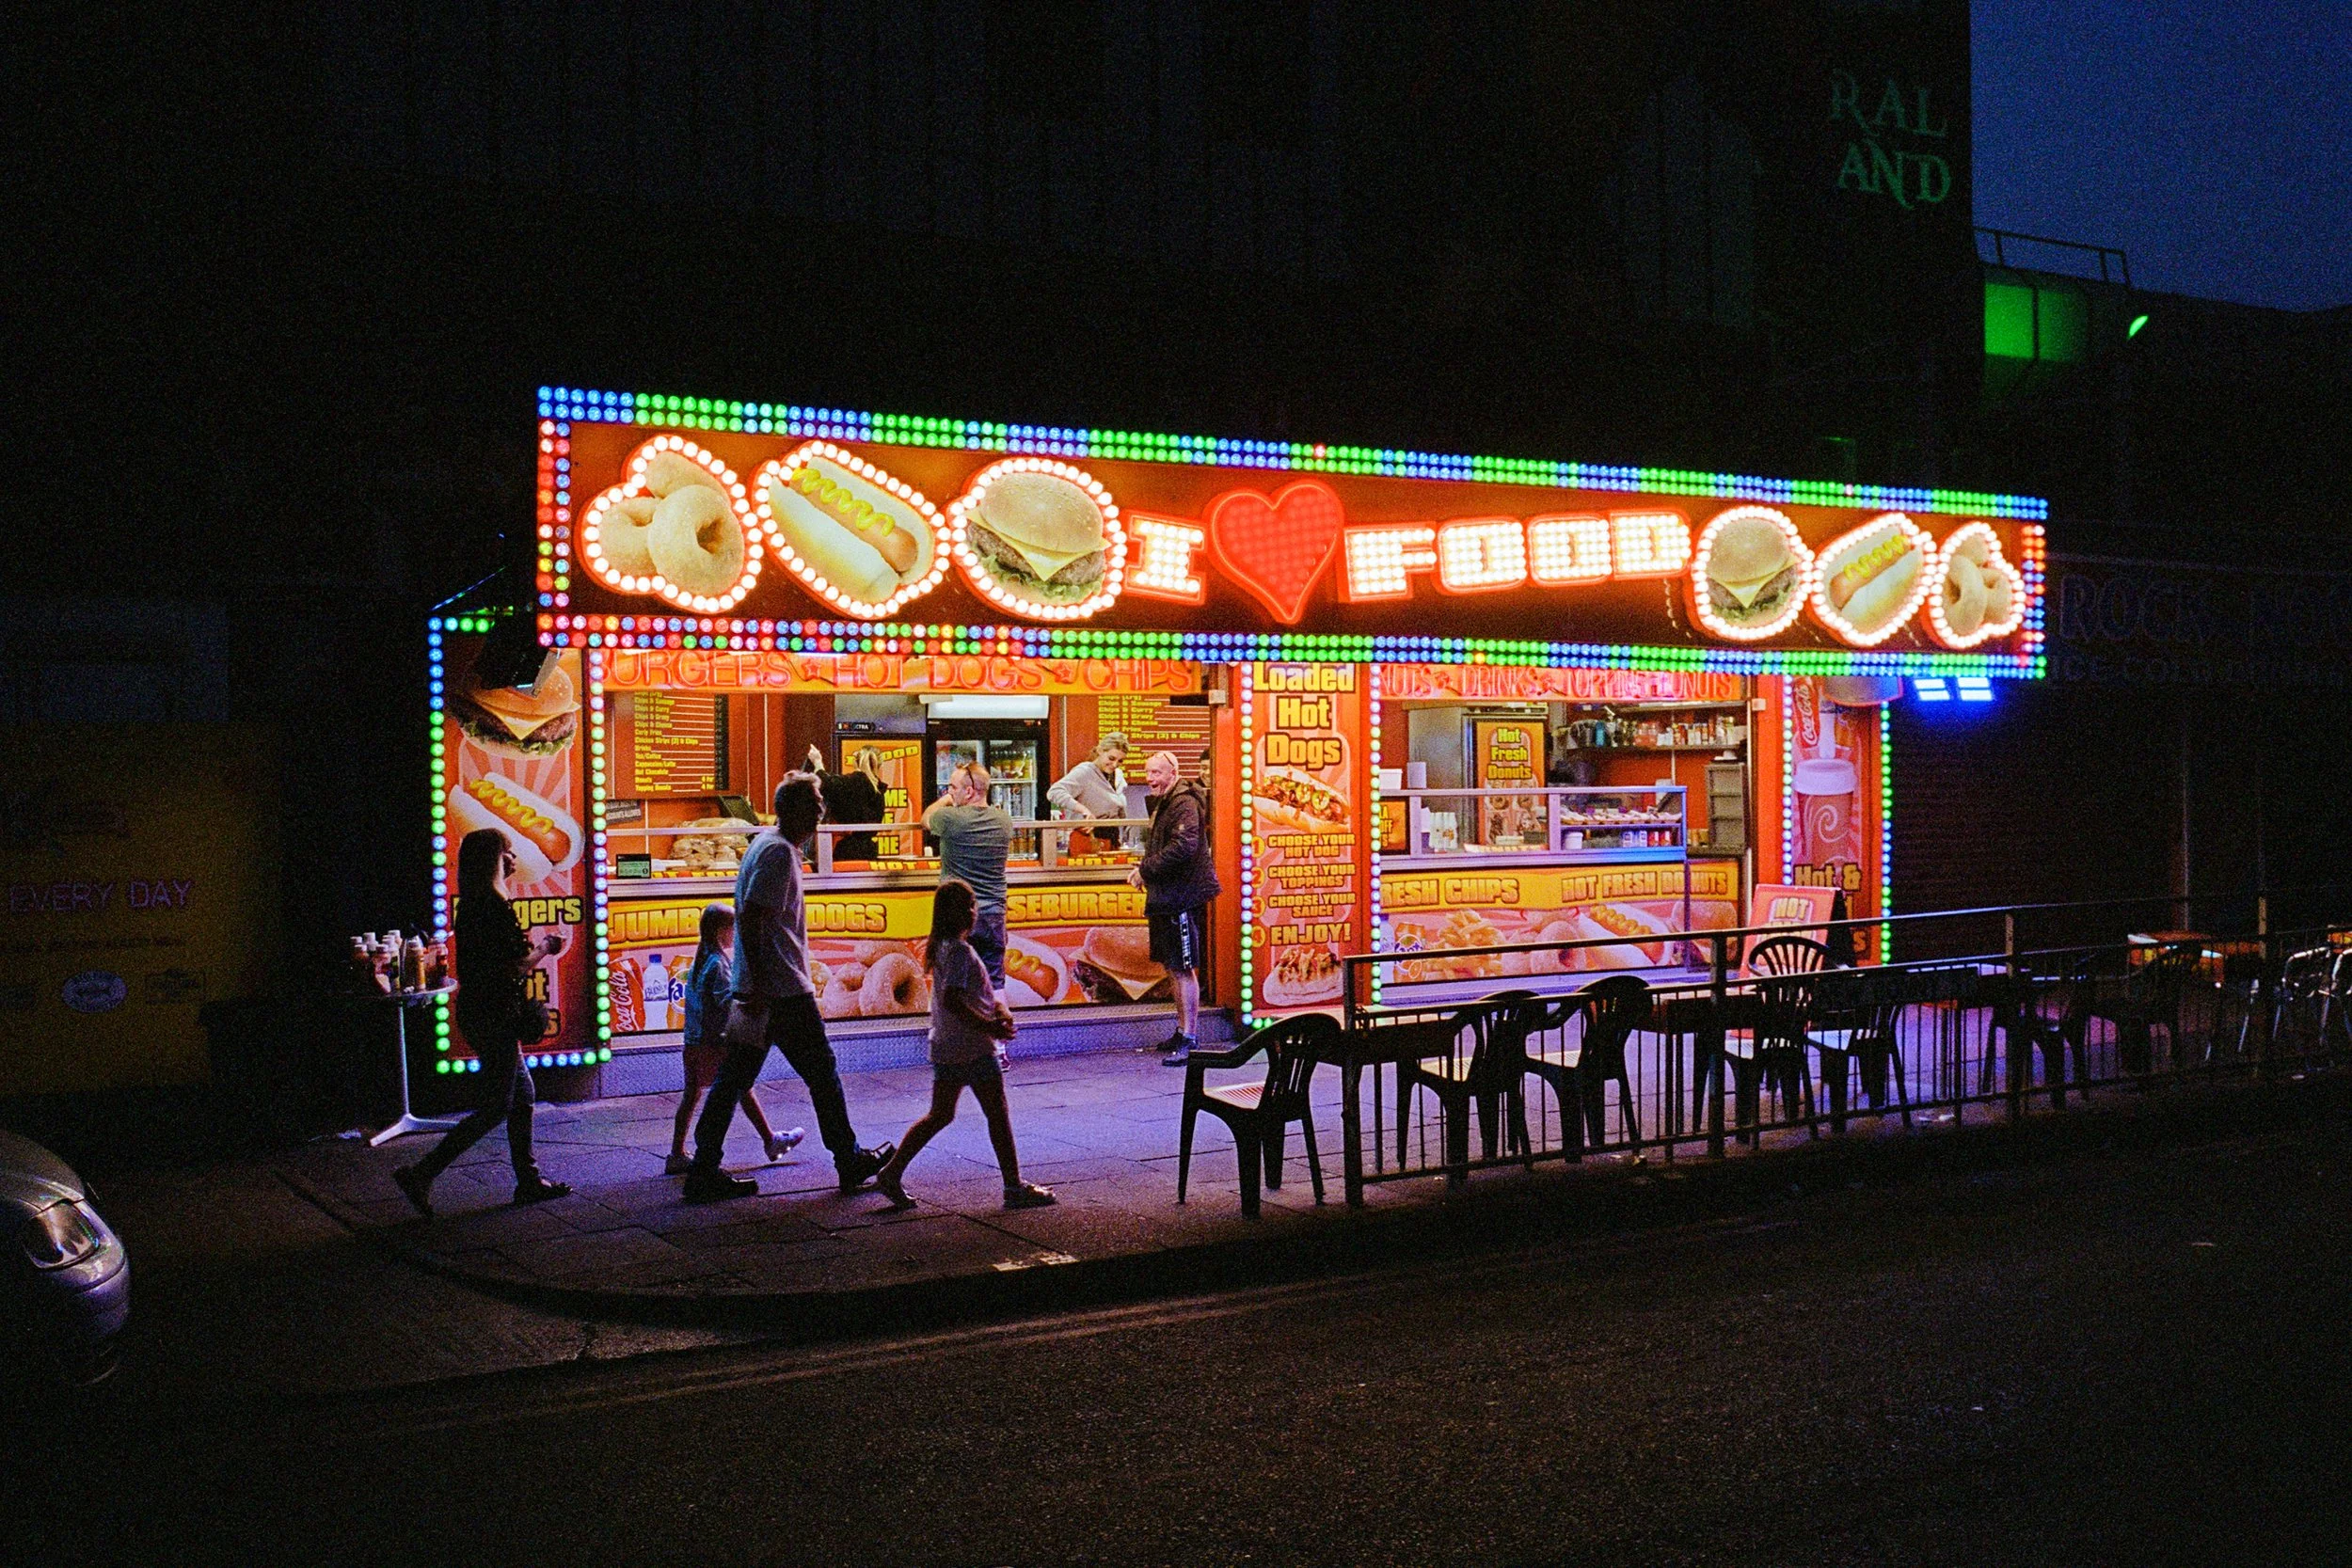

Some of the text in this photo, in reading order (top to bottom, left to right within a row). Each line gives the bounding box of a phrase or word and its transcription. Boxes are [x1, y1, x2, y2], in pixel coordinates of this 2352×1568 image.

[1829, 68, 1948, 138] RAL
[1837, 136, 1952, 211] AND
[1125, 509, 1692, 606] I FOOD
[2058, 573, 2214, 646] ROCK
[834, 653, 911, 689] HOT
[930, 656, 1045, 690] DOGS
[1084, 657, 1193, 691] CHIPS
[1252, 660, 1356, 693] Loaded
[1379, 662, 1433, 698] NUTS
[1462, 664, 1538, 697] DRINKS
[1276, 695, 1332, 730] Hot
[1497, 727, 1522, 744] Hot
[882, 746, 919, 762] OOD
[1265, 732, 1343, 771] Dogs
[1490, 745, 1529, 762] Fresh
[1486, 764, 1533, 781] Donuts
[1268, 834, 1319, 847] CHOOSE
[1321, 833, 1355, 846] YOUR
[1284, 846, 1341, 859] HOT DOG
[869, 861, 917, 870] HOT
[1268, 864, 1319, 879] CHOOSE
[1321, 863, 1356, 876] YOUR
[1793, 862, 1862, 893] Hot &
[8, 879, 194, 913] EVERY DAY
[1280, 876, 1344, 889] TOPPINGS
[1381, 878, 1520, 909] RESH CHIPS
[1561, 870, 1729, 903] HOT FRESH DONUTS
[1006, 892, 1147, 922] SEBURGER
[1268, 894, 1319, 908] CHOOSE
[1322, 892, 1356, 905] YOUR
[1291, 905, 1334, 918] SAUCE
[1772, 896, 1810, 920] HOT
[607, 902, 886, 943] JUMB DOGS
[1270, 922, 1352, 946] ENJOY!
